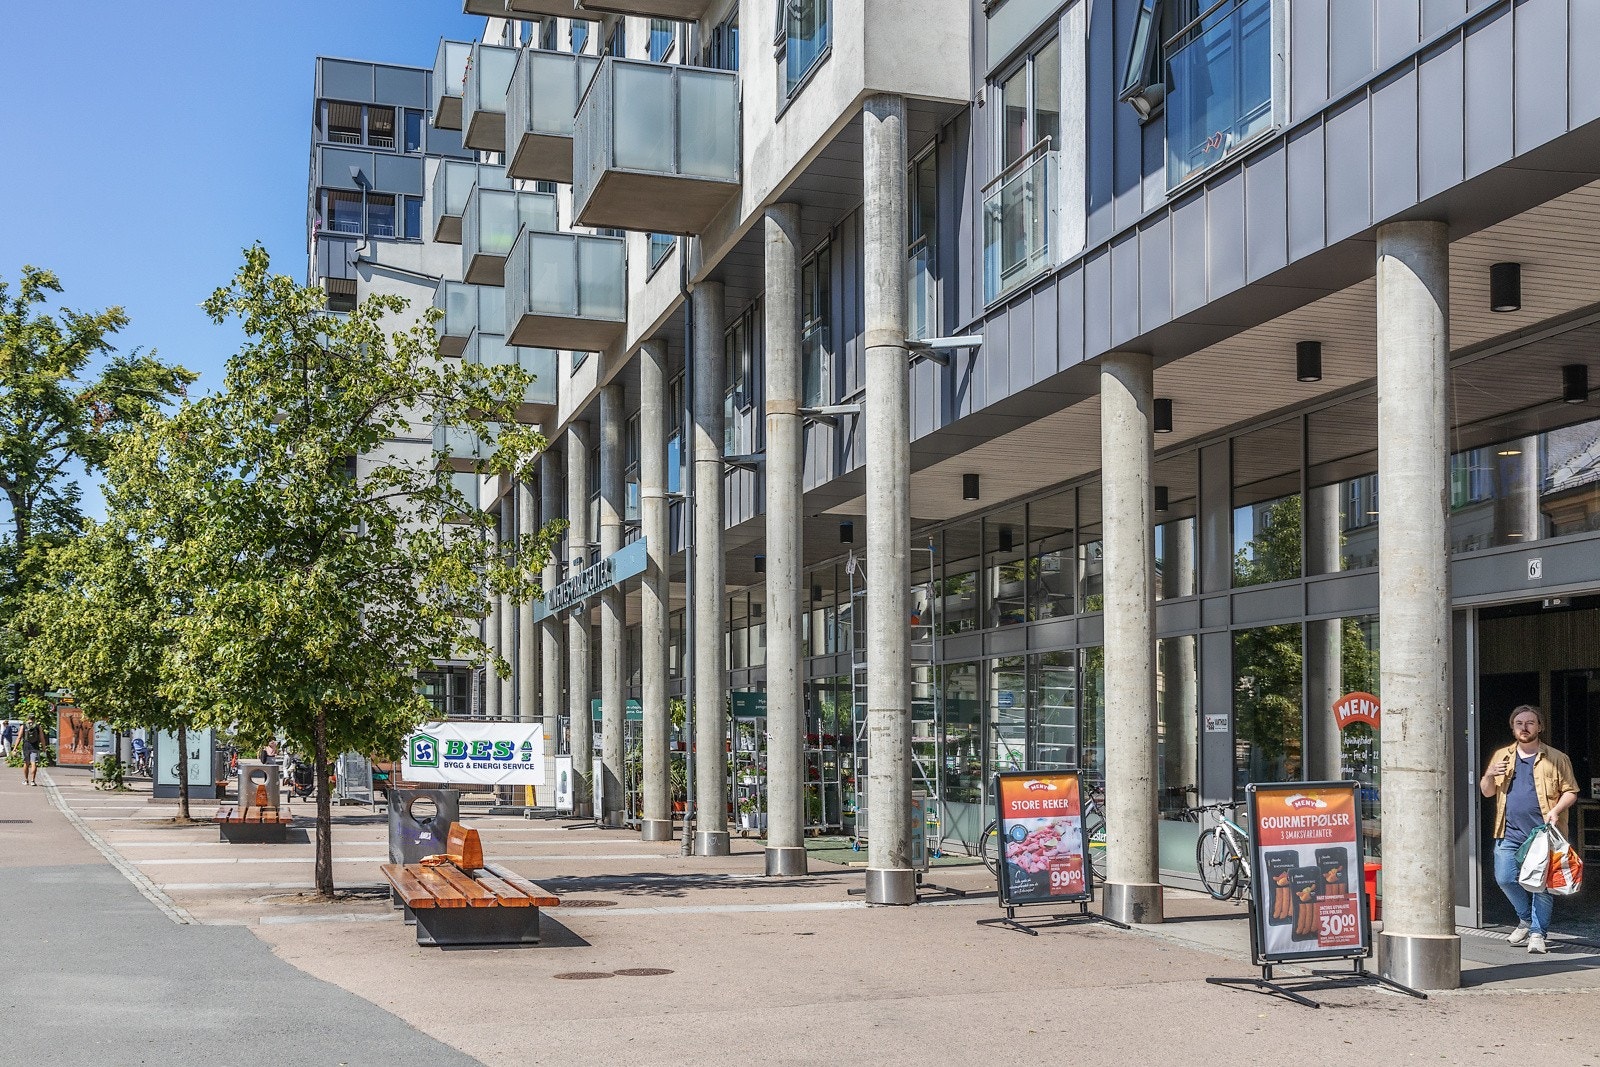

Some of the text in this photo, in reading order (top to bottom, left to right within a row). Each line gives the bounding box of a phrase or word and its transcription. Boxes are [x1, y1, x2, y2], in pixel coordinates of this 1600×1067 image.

[1338, 698, 1380, 721] MENY
[443, 739, 515, 761] BES
[443, 761, 464, 769] BYGG
[472, 762, 501, 770] ENERGI
[1030, 784, 1048, 792] MENY
[1011, 798, 1069, 811] STORE REKER
[1294, 799, 1315, 808] MENY
[1261, 813, 1350, 829] GOURMETPØLSER
[1280, 828, 1333, 840] 3 SMAKSVARIANTER
[1319, 913, 1356, 937] 3000
